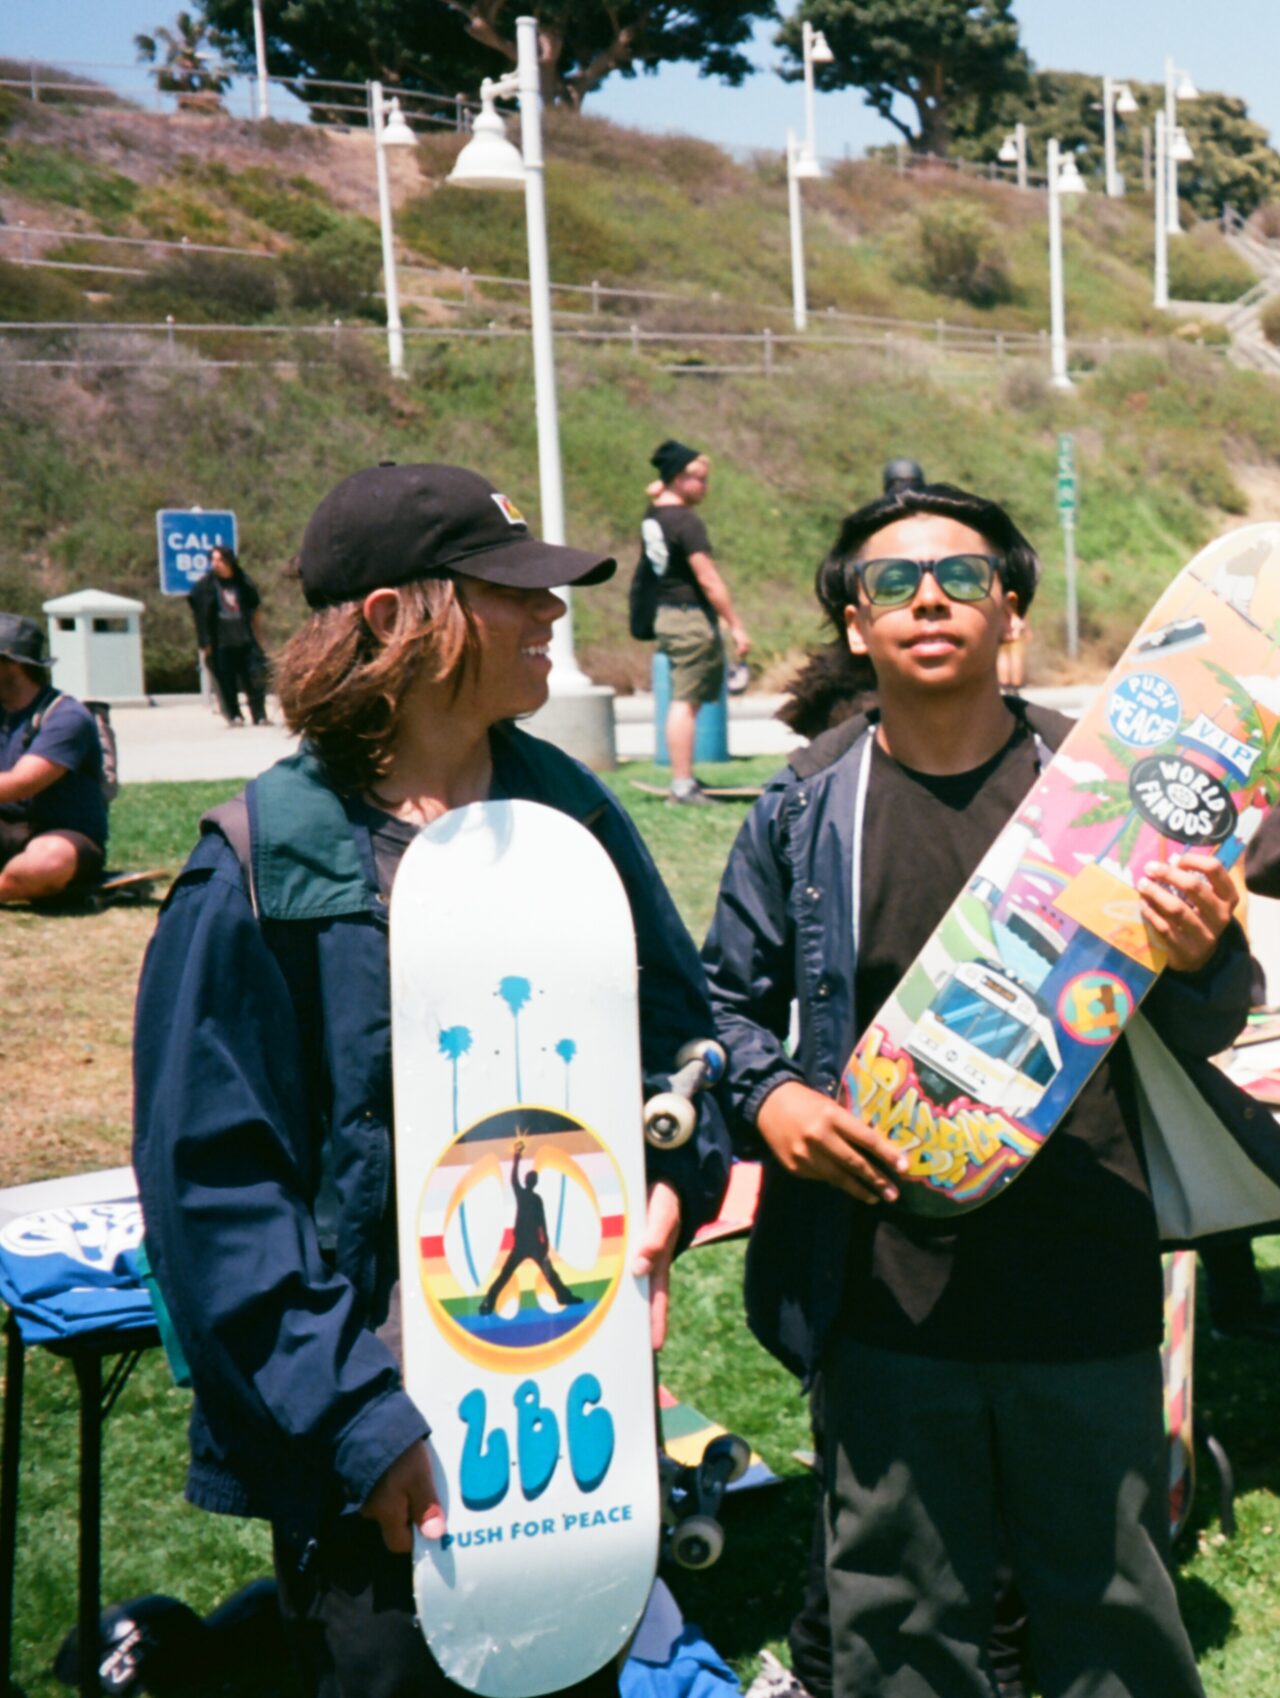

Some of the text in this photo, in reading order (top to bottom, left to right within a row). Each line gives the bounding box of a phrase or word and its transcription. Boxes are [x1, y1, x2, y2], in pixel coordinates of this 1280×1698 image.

[176, 553, 209, 571] BO
[1128, 676, 1176, 708] PUSH
[1110, 694, 1176, 743] PEACE
[1199, 721, 1253, 760] VIP
[1135, 779, 1214, 836] FAMOUS
[1158, 760, 1226, 812] WORLD
[441, 1504, 633, 1551] PUSH FOR PEACE
